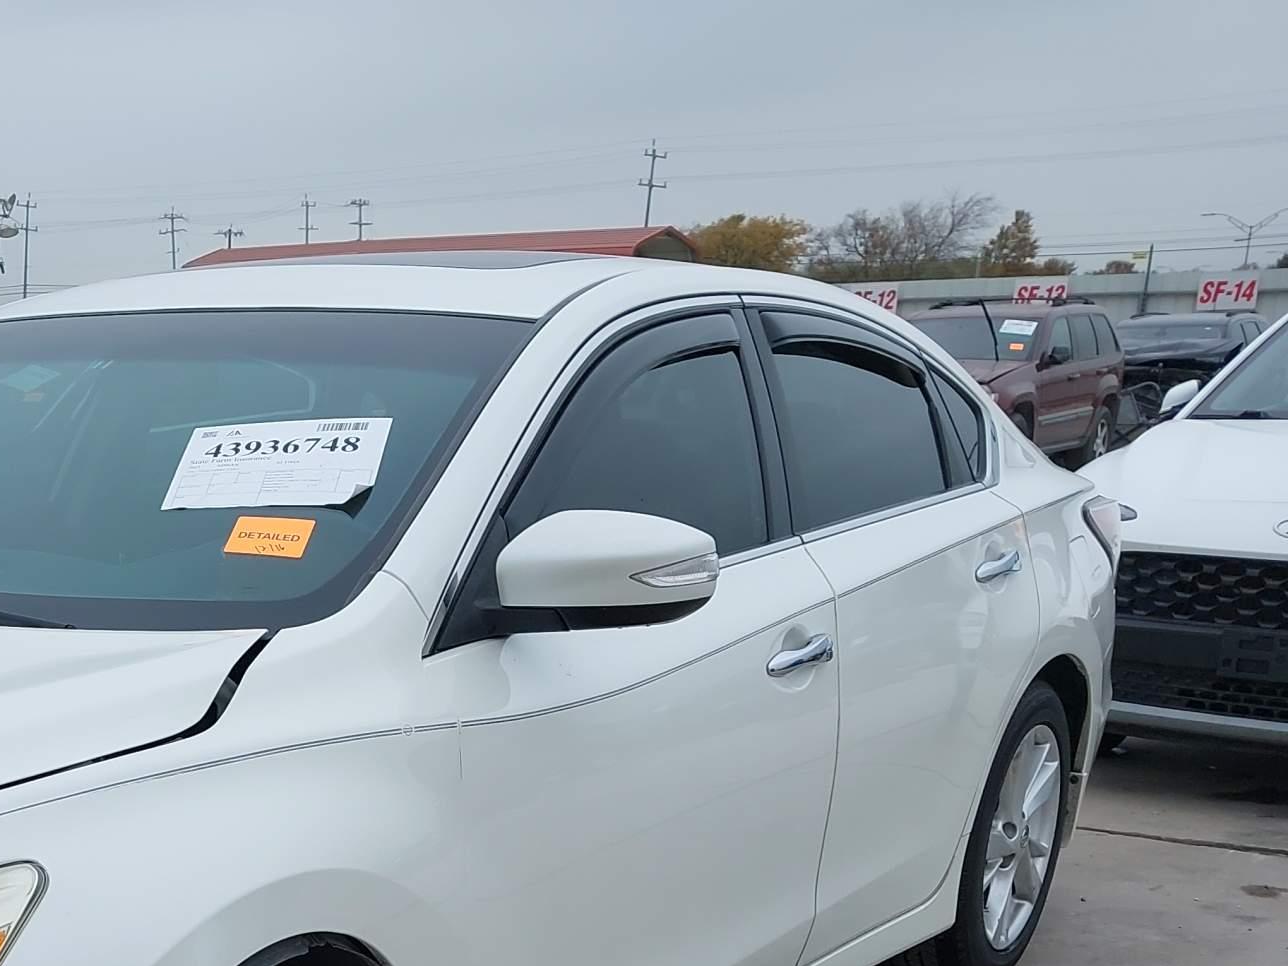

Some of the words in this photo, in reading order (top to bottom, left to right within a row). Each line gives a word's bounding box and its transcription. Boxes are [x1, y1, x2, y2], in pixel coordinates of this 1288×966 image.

[1199, 280, 1257, 304] SF-14
[204, 436, 361, 458] 43936748
[237, 531, 301, 542] DETAILED
